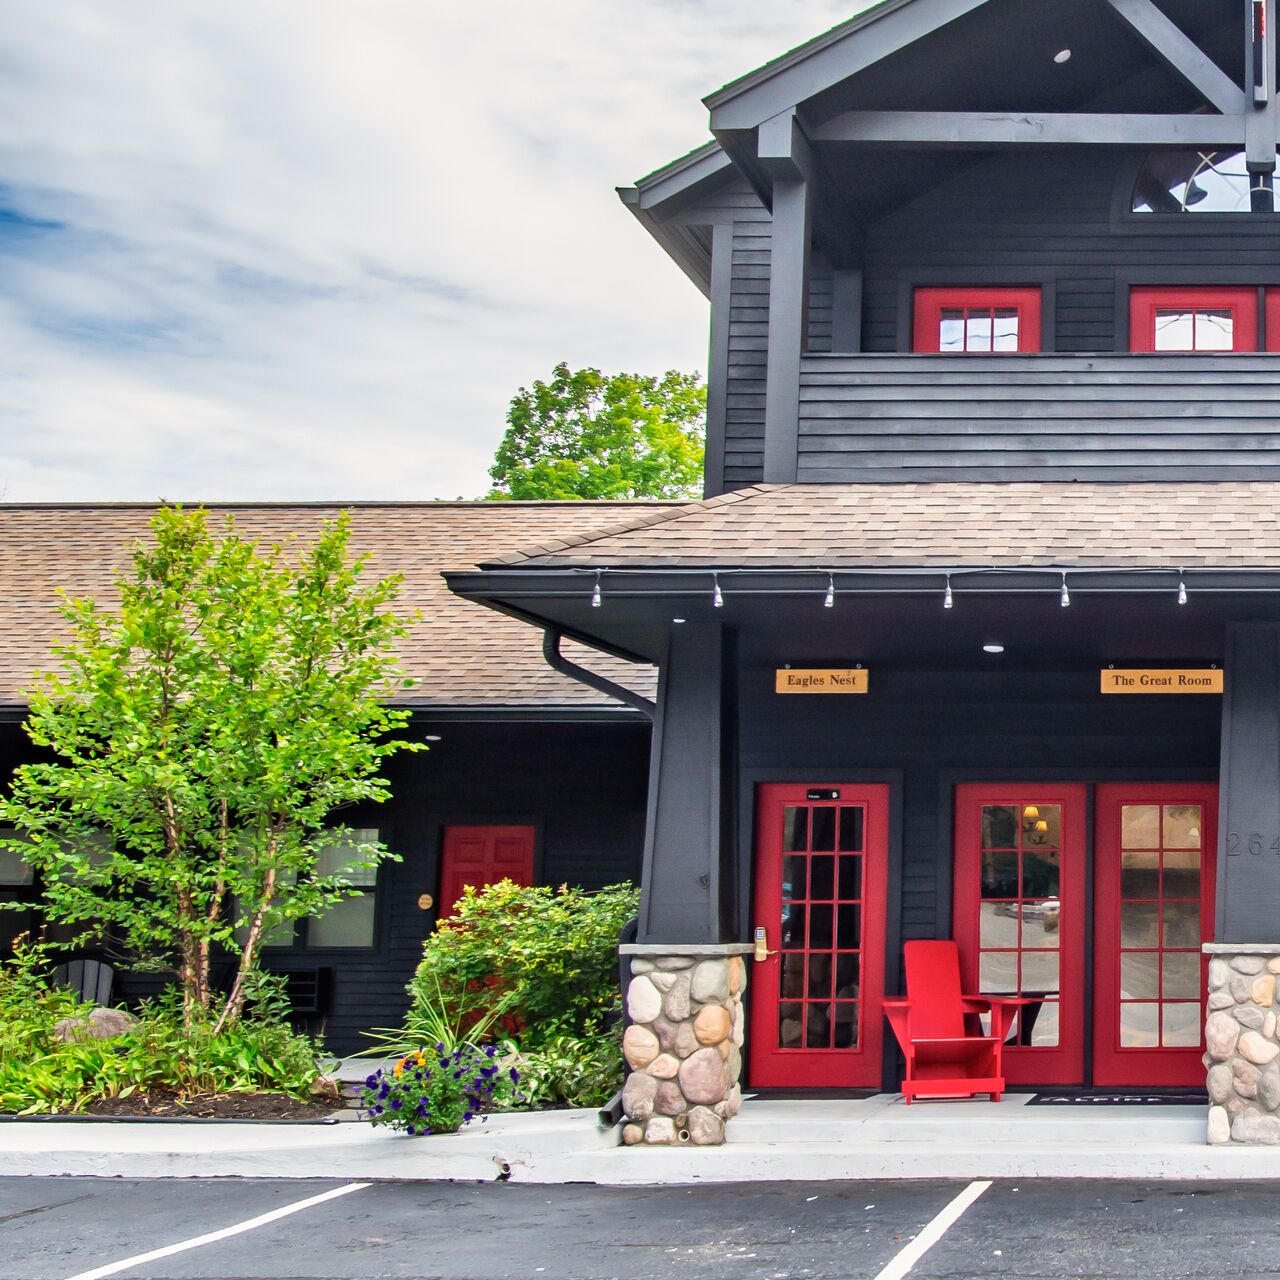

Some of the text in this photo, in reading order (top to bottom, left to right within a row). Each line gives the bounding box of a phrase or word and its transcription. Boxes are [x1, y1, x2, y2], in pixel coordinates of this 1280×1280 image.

[787, 674, 857, 688] Eagles Nest
[1112, 674, 1212, 686] The Great Room
